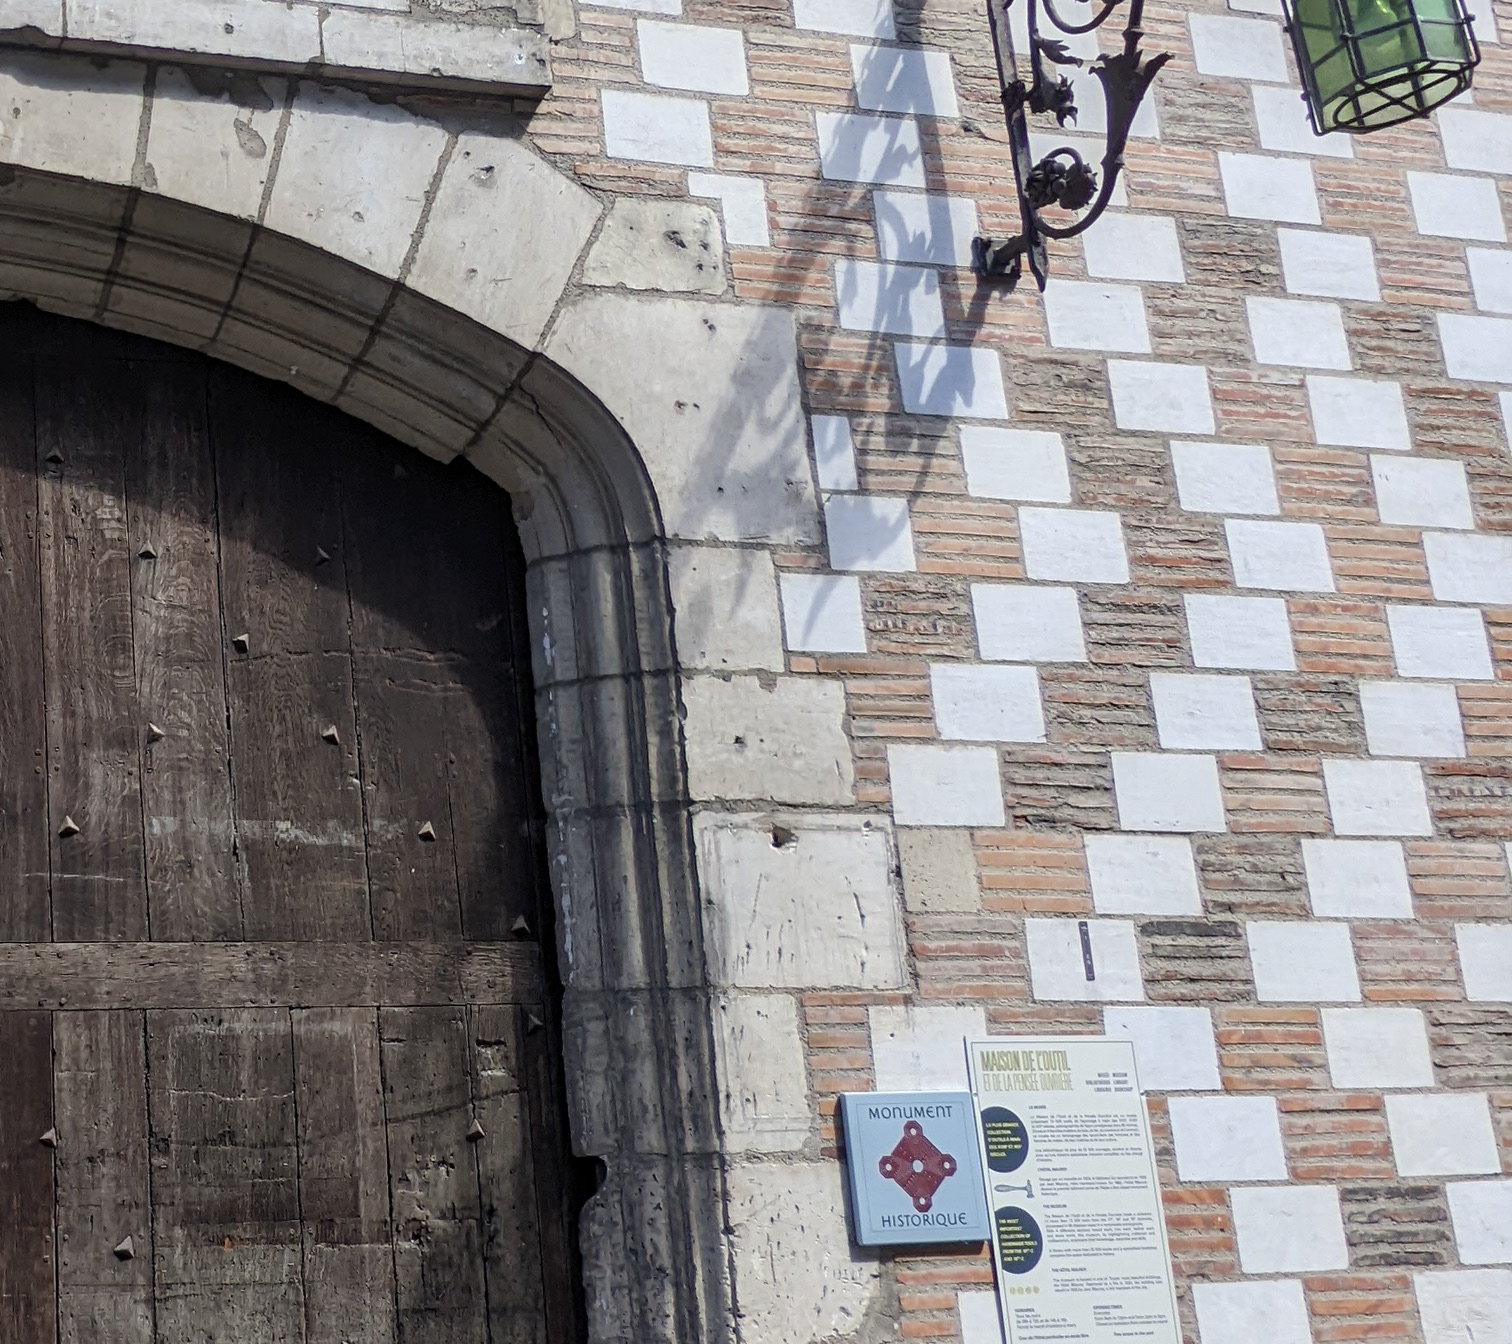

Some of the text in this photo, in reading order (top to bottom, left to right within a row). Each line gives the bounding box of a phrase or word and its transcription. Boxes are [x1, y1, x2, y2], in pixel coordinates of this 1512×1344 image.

[980, 1050, 1021, 1072] MAISON
[1021, 1050, 1036, 1072] DE
[868, 1105, 953, 1120] MONUMENT
[881, 1212, 968, 1228] HISTORIQUE
